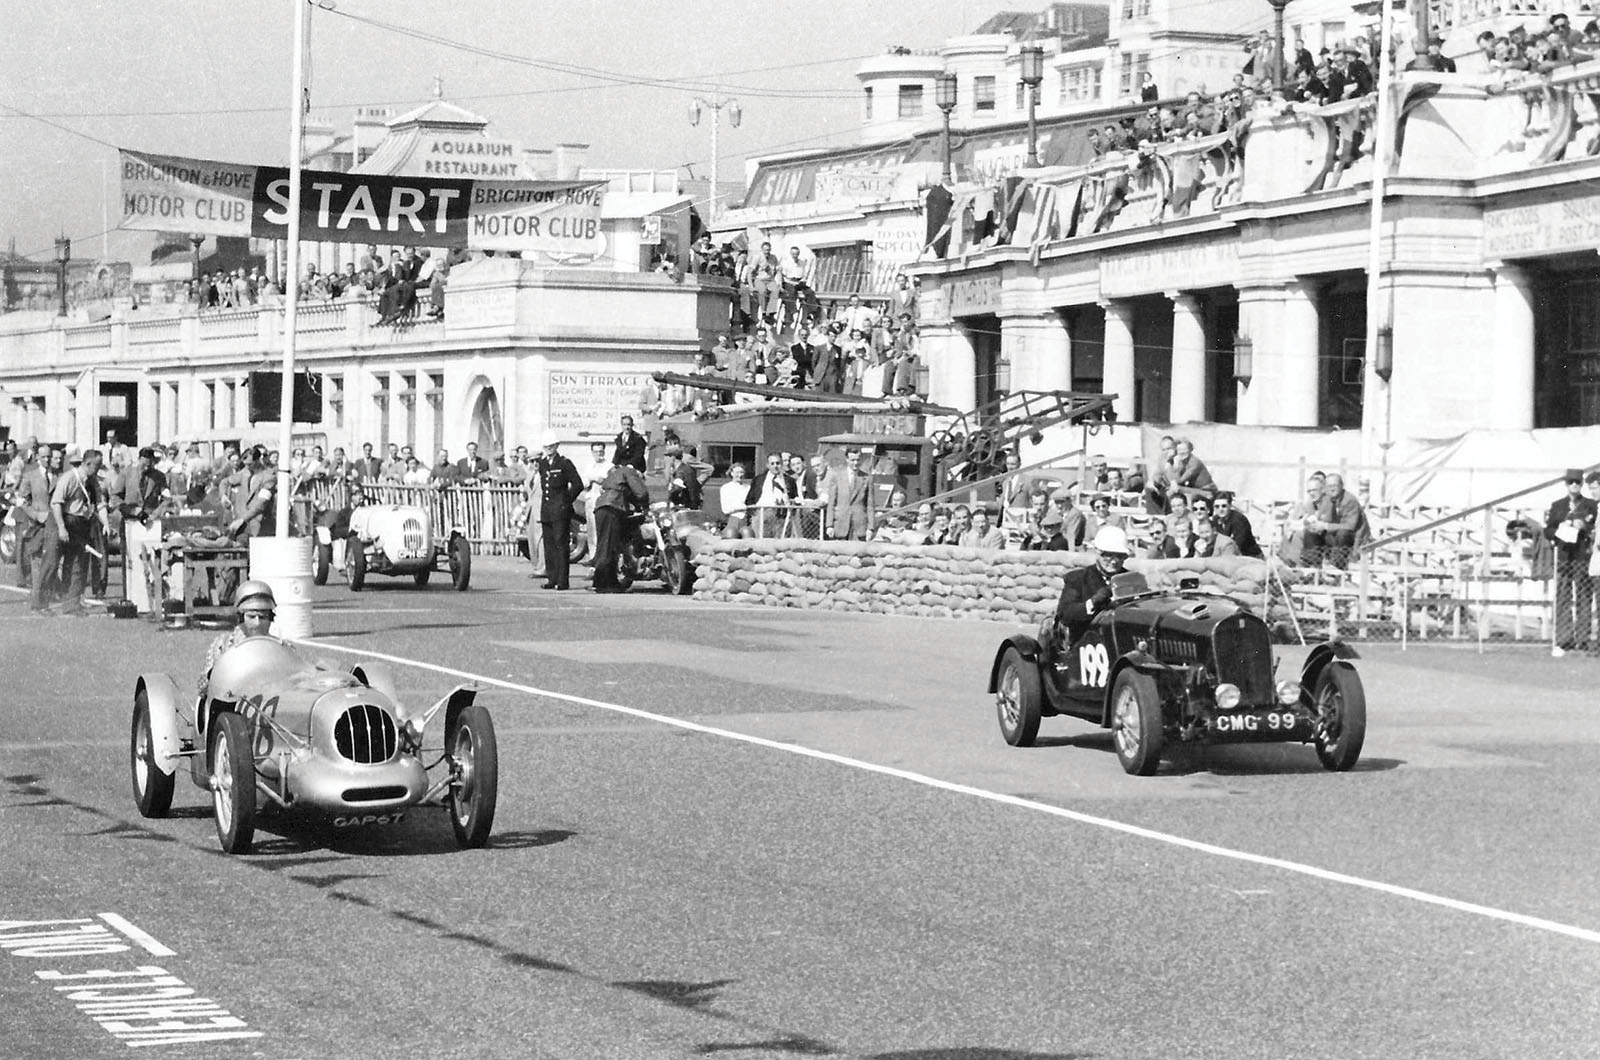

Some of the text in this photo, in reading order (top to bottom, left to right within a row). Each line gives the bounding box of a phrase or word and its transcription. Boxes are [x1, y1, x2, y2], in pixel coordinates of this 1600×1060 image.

[431, 141, 513, 156] AQUARIUM
[124, 161, 201, 185] BRIGHTON
[213, 170, 252, 189] HOVE
[425, 160, 518, 176] RESTAURANT
[474, 188, 554, 204] BRIGHTON
[565, 188, 601, 207] HOVE
[761, 169, 804, 202] SUN
[123, 193, 246, 222] MOTOR CLUB
[263, 178, 460, 234] START
[474, 214, 597, 239] MOTOR CLUB
[552, 375, 577, 385] SUN
[584, 376, 637, 386] TERRACE
[1079, 644, 1109, 687] 199
[1216, 712, 1295, 731] CMG 99
